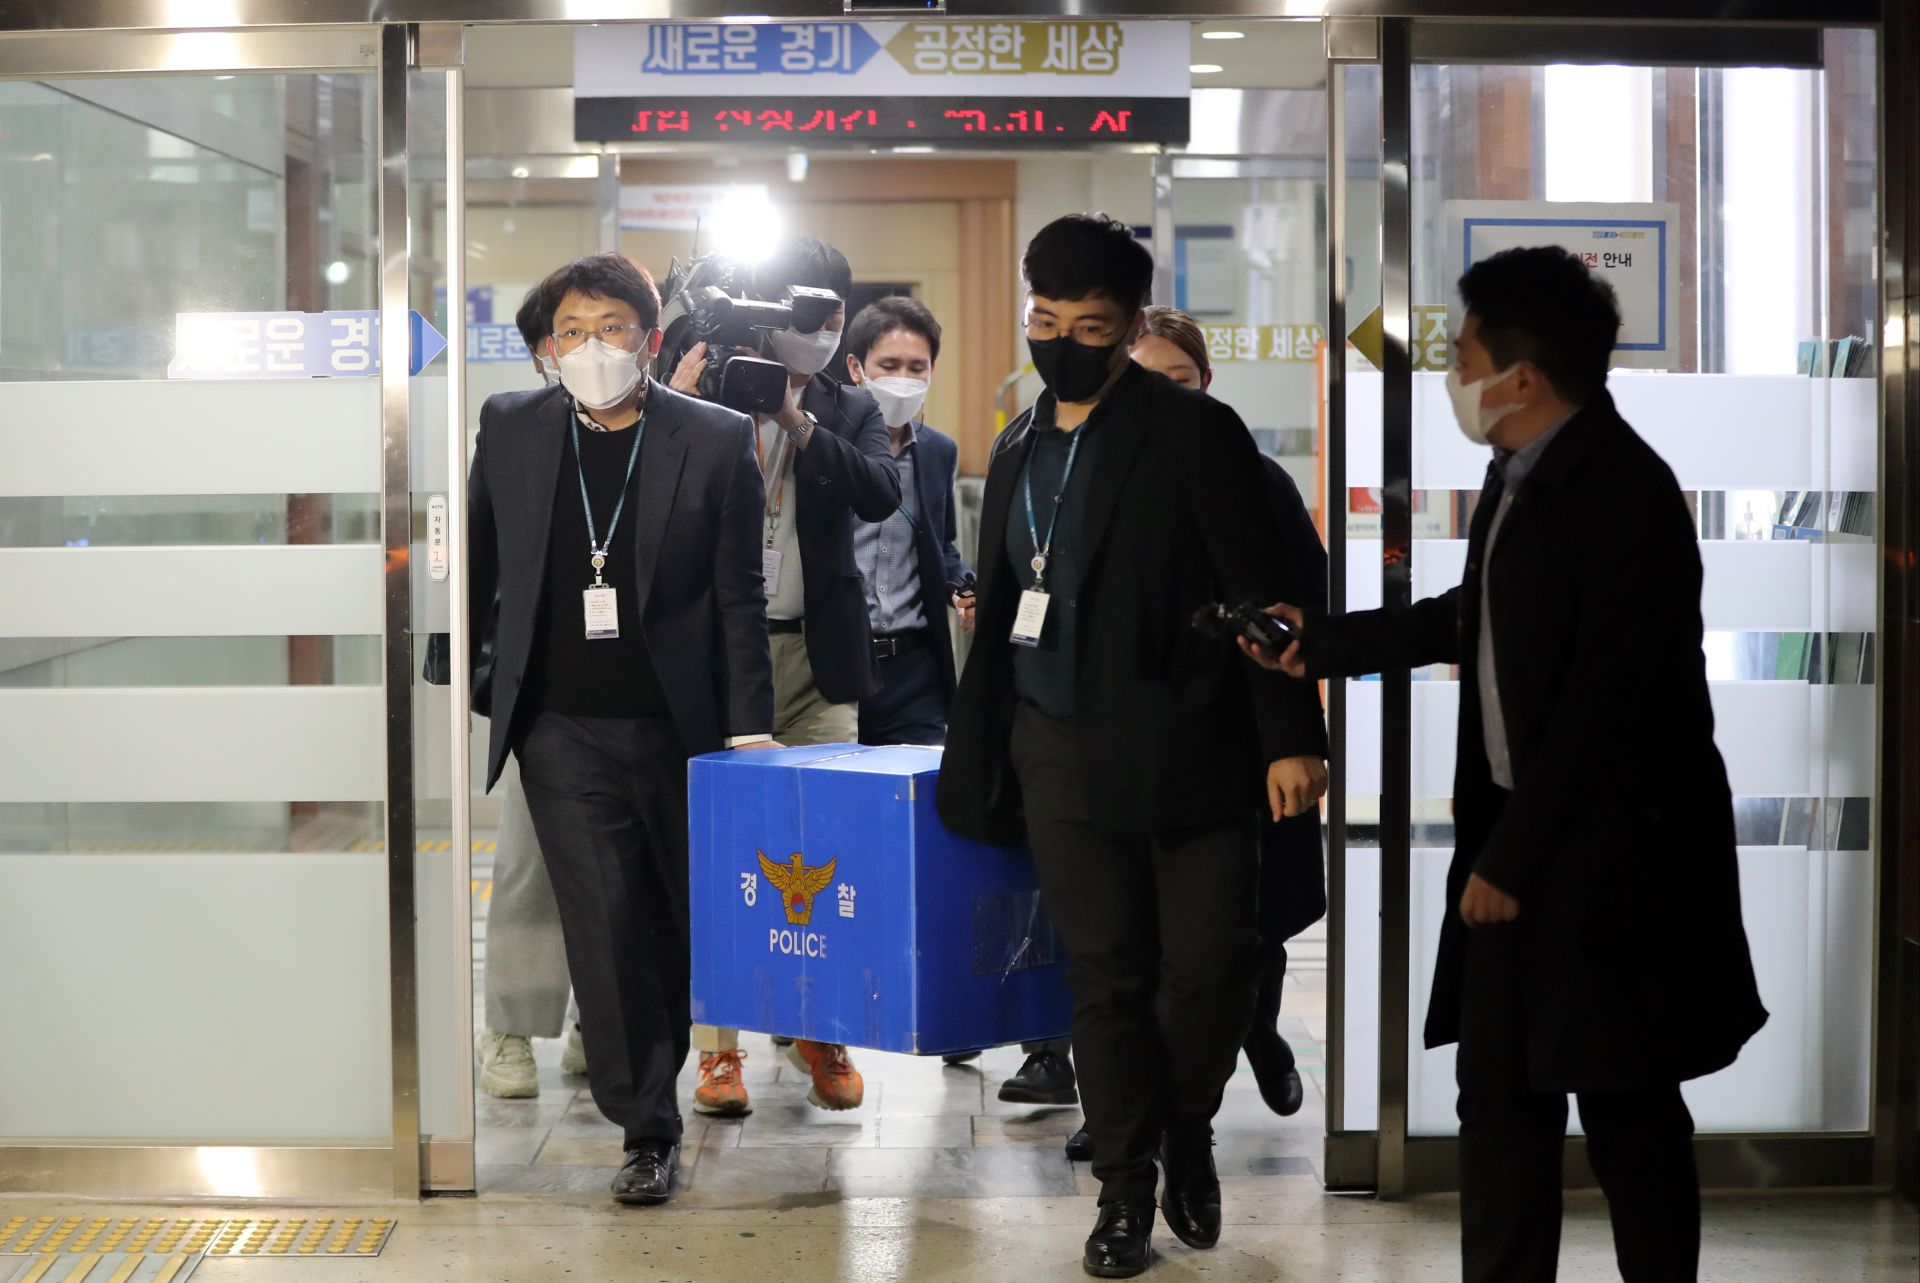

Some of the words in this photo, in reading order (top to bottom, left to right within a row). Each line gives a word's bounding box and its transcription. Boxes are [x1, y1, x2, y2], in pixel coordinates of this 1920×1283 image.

[646, 24, 758, 71] 새로운
[780, 24, 853, 71] 경기
[913, 24, 1026, 71] 공정한
[1041, 24, 1119, 71] 세상
[1603, 252, 1632, 269] 안내
[176, 318, 305, 374] 로운
[1201, 326, 1259, 361] 정한
[1268, 326, 1321, 360] 세상
[740, 872, 758, 907] 경
[837, 882, 857, 919] 찰
[769, 928, 827, 959] POLICE
